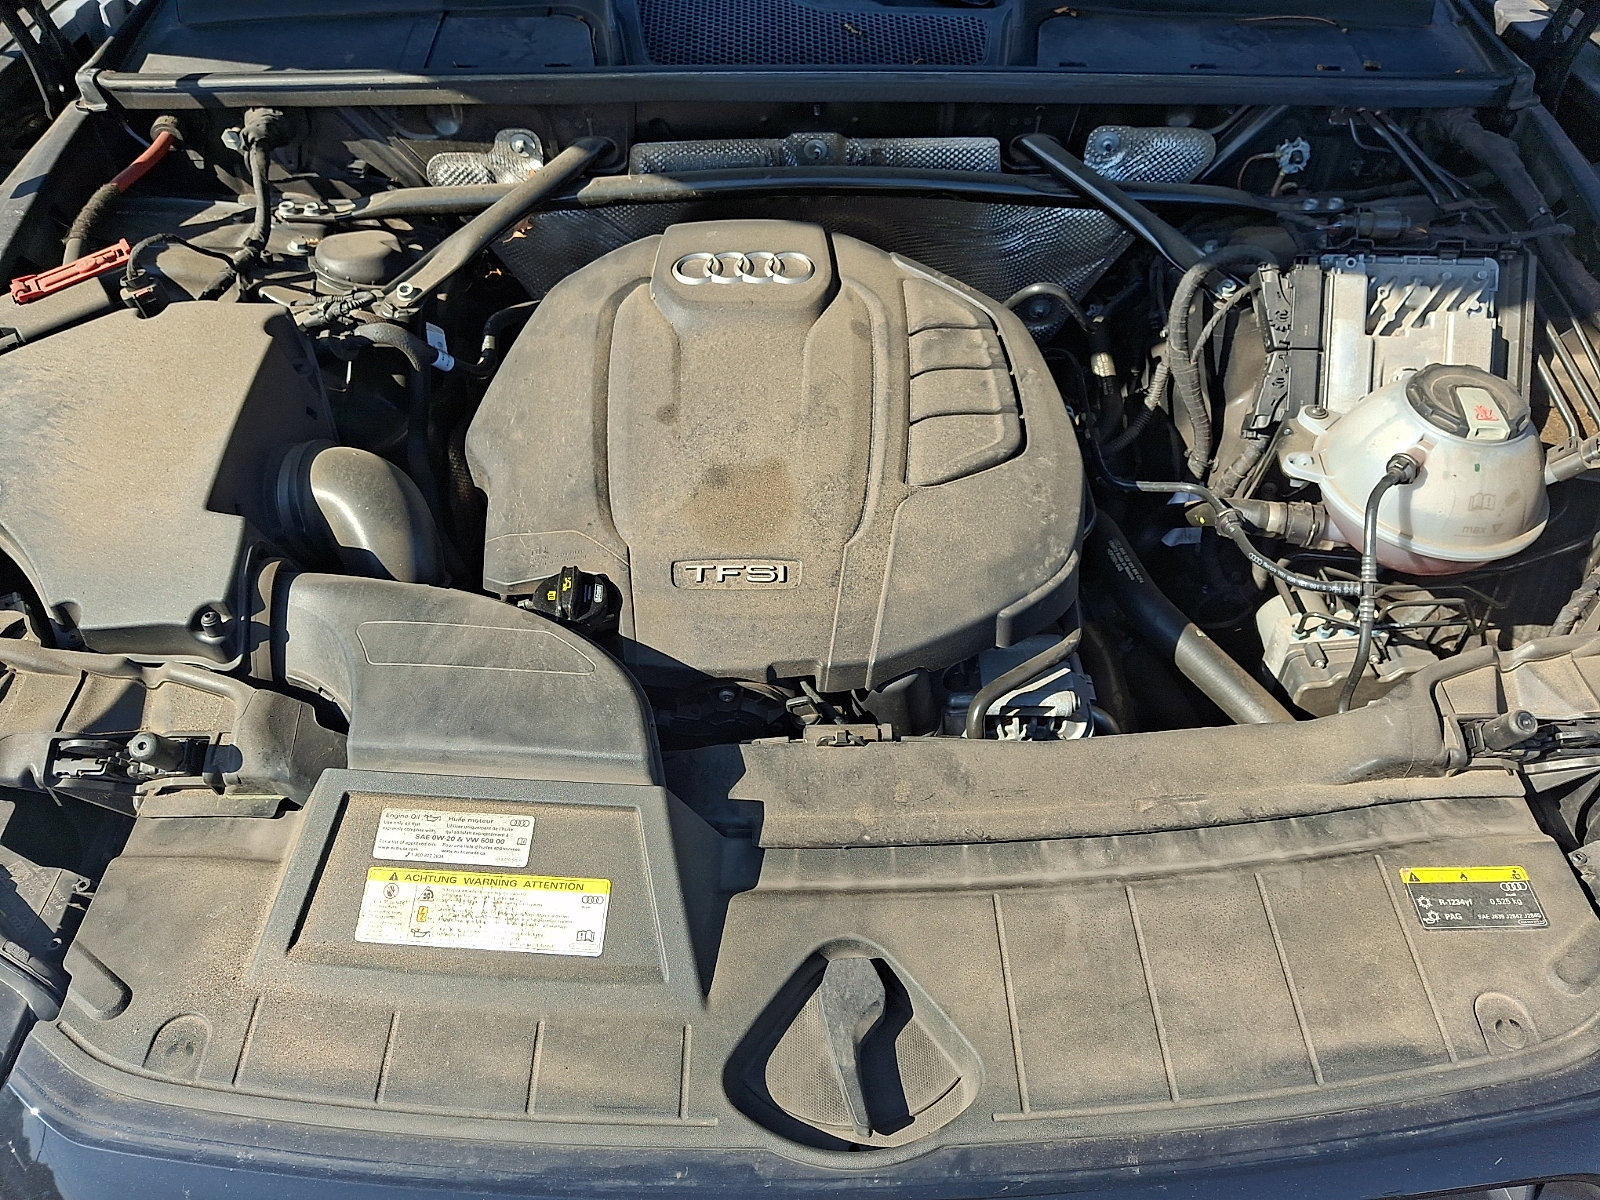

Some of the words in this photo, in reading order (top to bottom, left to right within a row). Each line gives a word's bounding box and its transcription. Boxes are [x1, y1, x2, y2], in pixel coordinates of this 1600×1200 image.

[684, 564, 788, 583] TFSI
[385, 812, 409, 820] Engine
[415, 833, 431, 841] SAE
[404, 873, 457, 884] ACHTUNG
[463, 877, 518, 888] WARNING
[523, 880, 585, 891] ATTENTION
[1489, 898, 1511, 906] 0,525
[1511, 898, 1523, 906] kg
[1443, 912, 1463, 921] PAG
